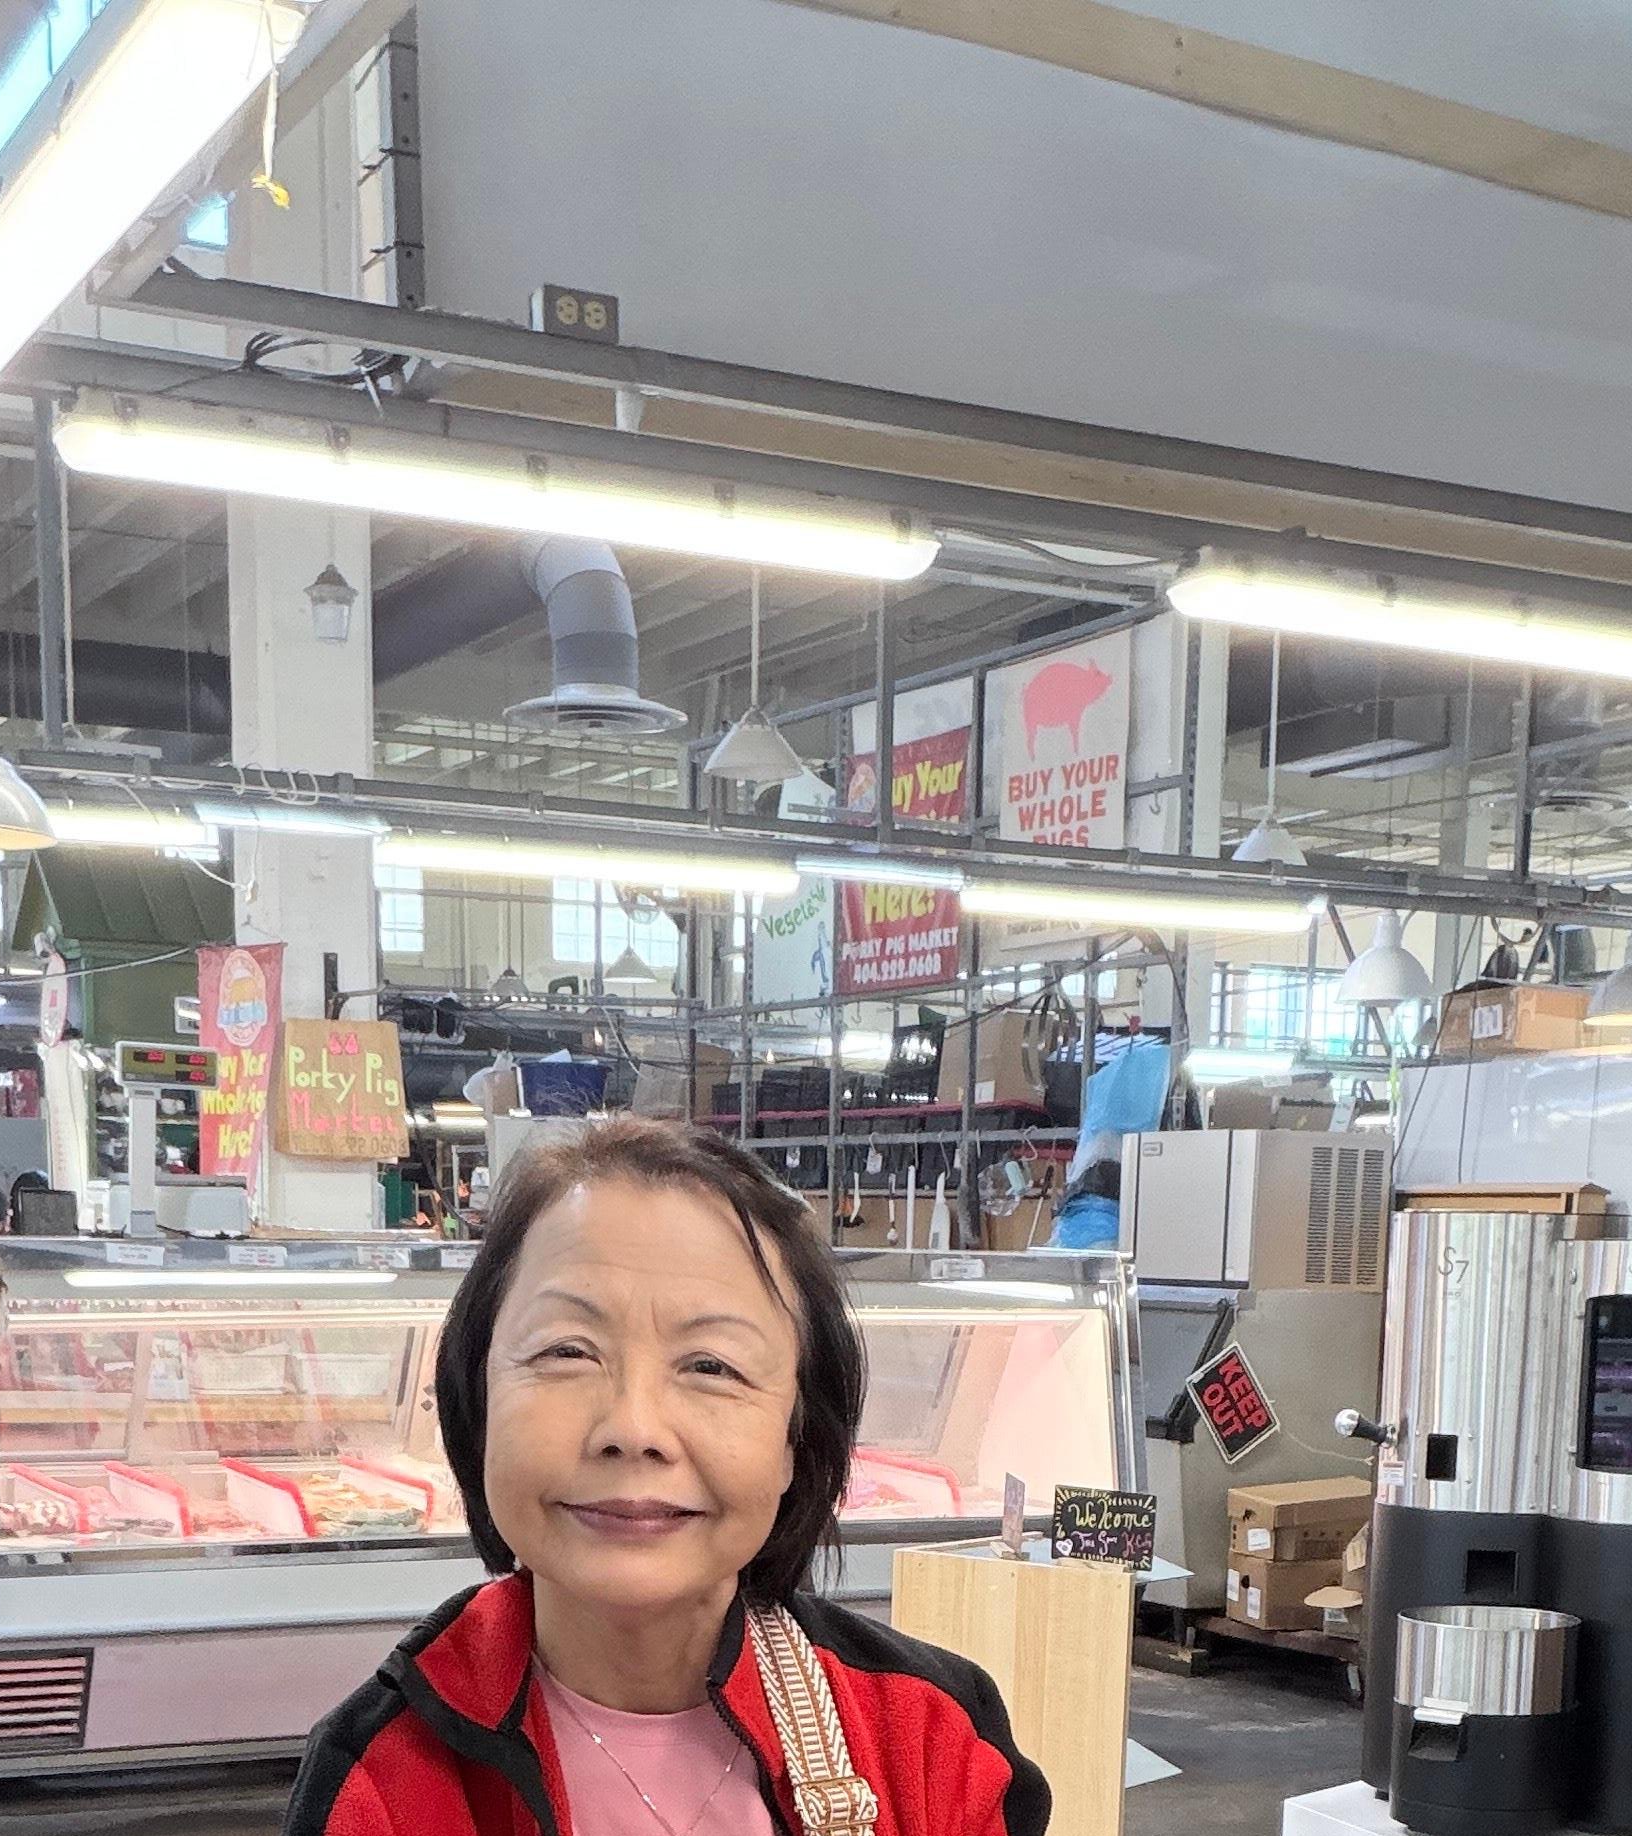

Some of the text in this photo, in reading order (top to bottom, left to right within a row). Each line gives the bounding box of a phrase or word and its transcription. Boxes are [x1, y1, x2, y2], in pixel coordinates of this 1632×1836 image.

[891, 758, 965, 812] uy Your
[1007, 754, 1120, 805] BUY YOUR
[1017, 789, 1107, 833] WHOLE
[841, 925, 959, 961] PORKY PIG MARKET
[288, 1044, 356, 1104] Porky
[365, 1051, 401, 1107] Pig
[1438, 1246, 1470, 1284] S7
[1202, 1382, 1245, 1438] OUT
[1218, 1354, 1269, 1428] KEEP
[1067, 1498, 1153, 1531] Welcome
